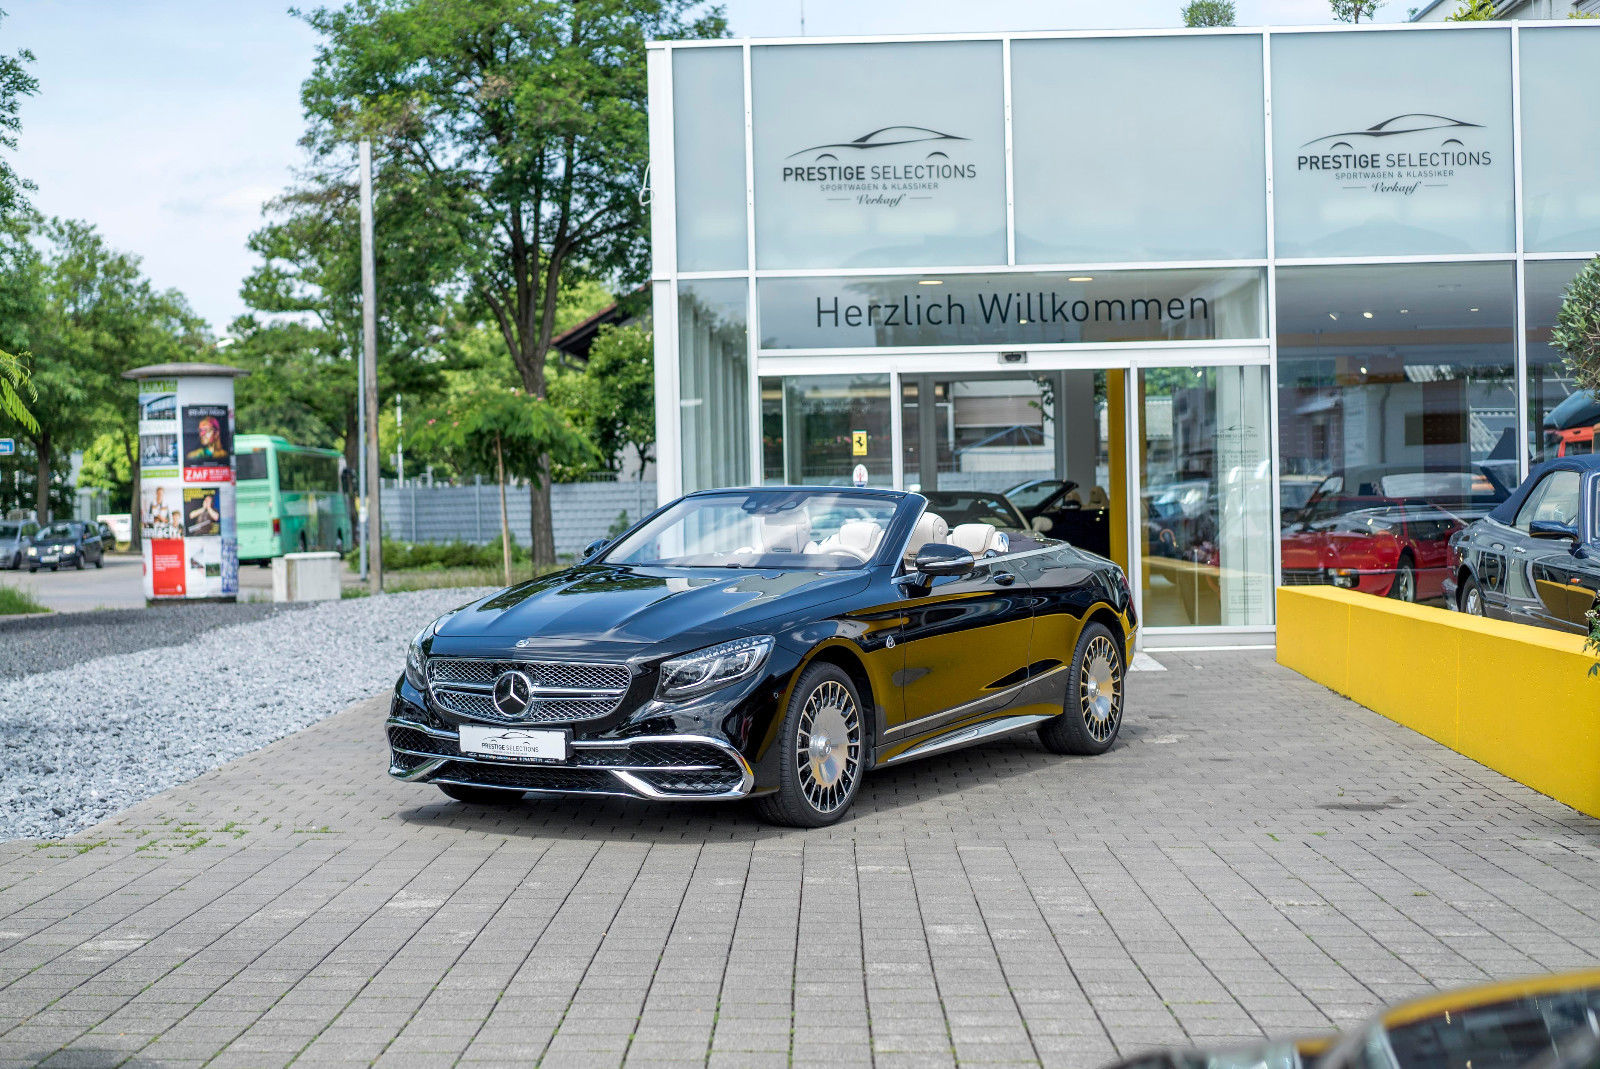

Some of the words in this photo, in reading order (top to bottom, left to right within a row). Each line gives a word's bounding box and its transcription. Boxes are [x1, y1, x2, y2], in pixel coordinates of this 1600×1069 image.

[1297, 154, 1380, 170] PRESTIGE
[1386, 151, 1492, 168] SELECTIONS
[782, 165, 865, 182] PRESTIGE
[871, 164, 977, 180] SELECTIONS
[1335, 171, 1394, 180] SPORTWAGEN
[1406, 169, 1455, 178] KLASSIKER
[820, 183, 879, 192] SPORTWAGEN
[891, 182, 939, 190] KLASSIKER
[1371, 181, 1422, 195] Verkauf
[856, 193, 907, 207] Verkauf
[816, 294, 965, 328] Herzlich
[978, 292, 1209, 325] Willkommen
[185, 469, 209, 481] ZMF
[481, 742, 506, 751] PRESTIGE
[506, 744, 539, 753] SELECTIONS
